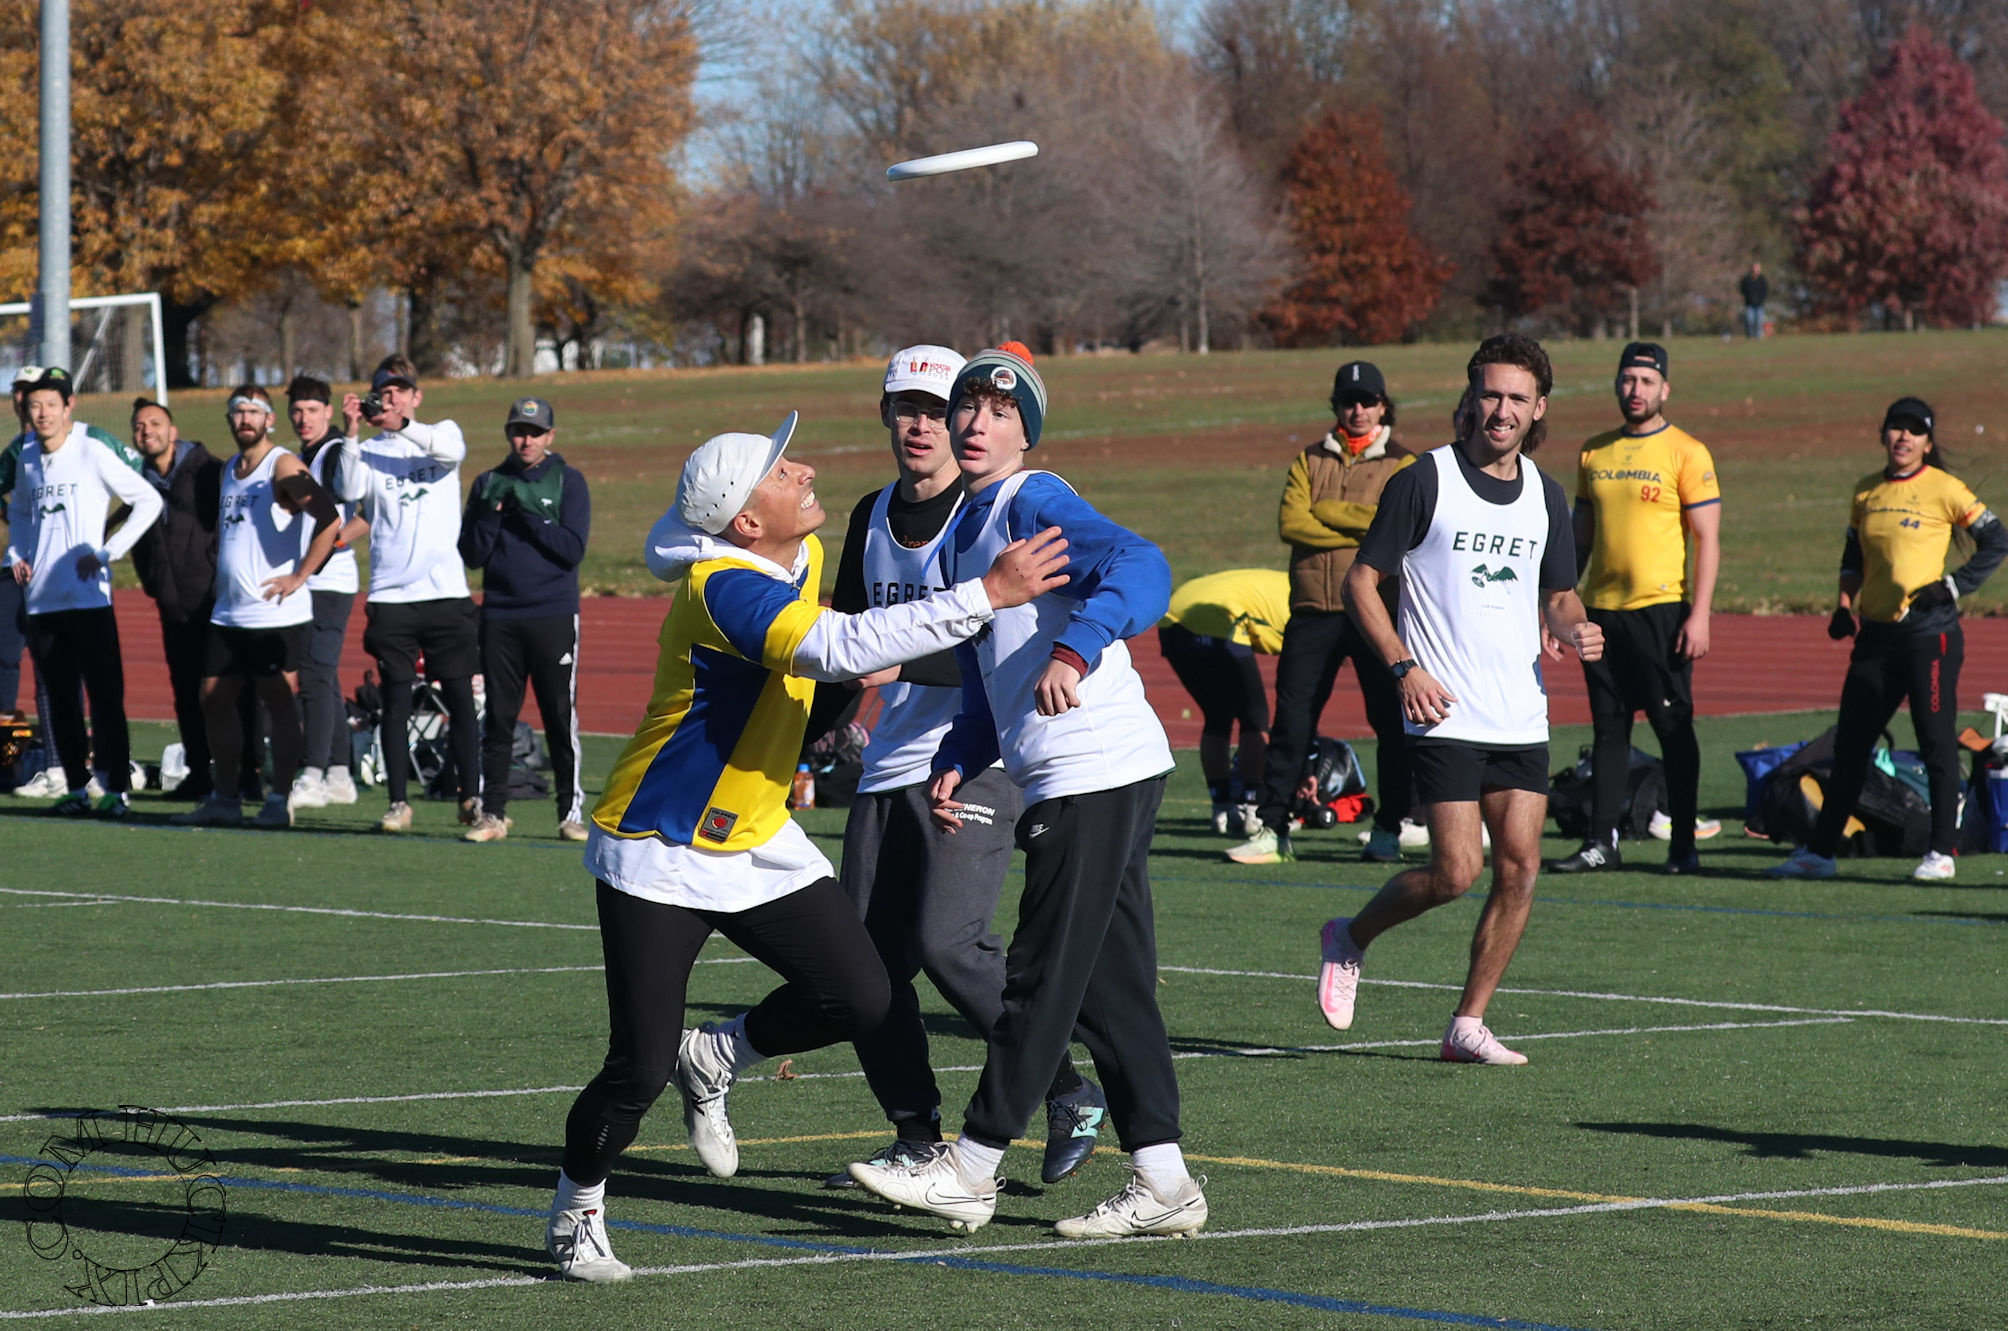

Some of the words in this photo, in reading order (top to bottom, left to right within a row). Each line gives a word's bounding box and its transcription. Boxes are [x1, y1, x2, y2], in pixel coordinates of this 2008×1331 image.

[1590, 469, 1662, 483] COLOMBIA
[1640, 485, 1661, 503] 92
[1900, 517, 1920, 529] 44
[1452, 531, 1538, 560] EGRET
[873, 582, 948, 605] EGRE
